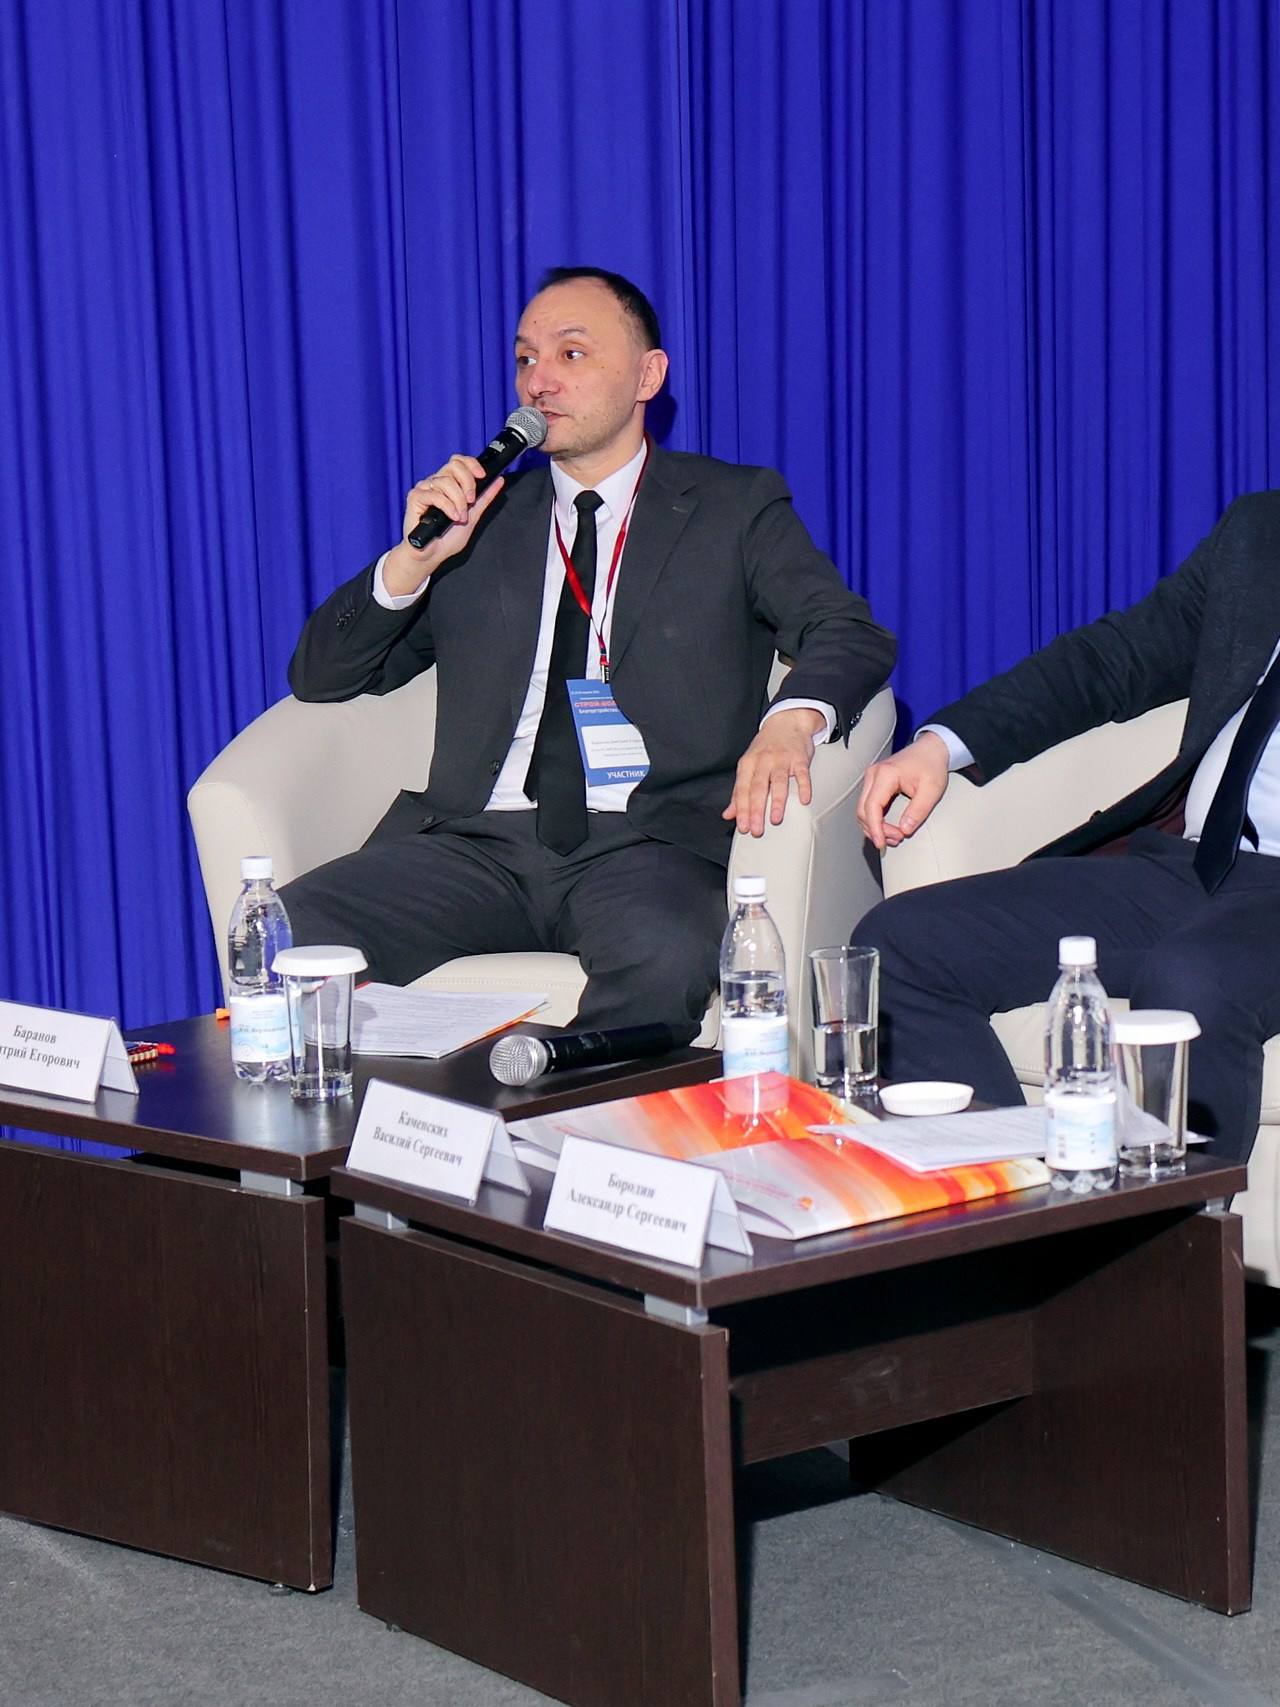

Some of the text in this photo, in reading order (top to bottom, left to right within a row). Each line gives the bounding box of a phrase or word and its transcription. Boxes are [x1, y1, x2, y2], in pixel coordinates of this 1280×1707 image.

[606, 769, 646, 779] УЧАСТНИК
[13, 1025, 57, 1043] Баранов
[29, 1048, 80, 1069] Егорович
[397, 1111, 449, 1138] Каменских
[373, 1126, 462, 1167] Василий Сергеевич
[607, 1173, 655, 1198] Бородин
[566, 1189, 687, 1233] Александр Сергеевич
